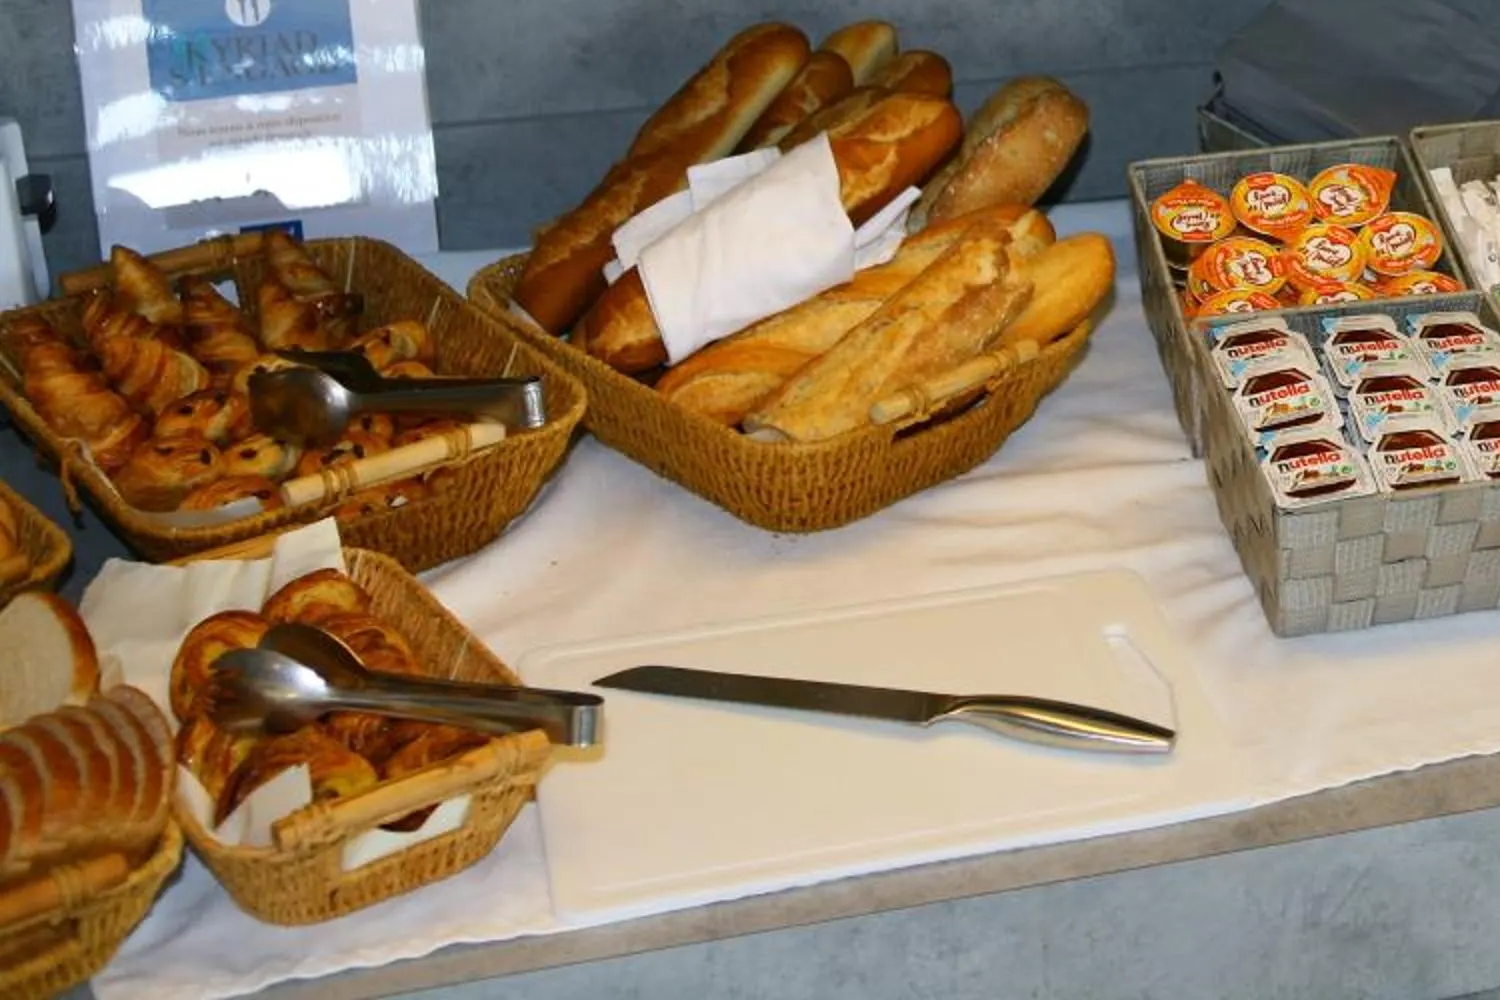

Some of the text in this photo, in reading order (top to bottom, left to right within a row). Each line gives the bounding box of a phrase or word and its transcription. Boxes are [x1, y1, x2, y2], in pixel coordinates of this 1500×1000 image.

[183, 30, 318, 66] KYRIAD
[1228, 337, 1289, 359] nutella
[1339, 338, 1399, 354] nutella
[1427, 333, 1485, 350] nutella
[1249, 383, 1311, 408] nutella
[1363, 389, 1425, 406] nutella
[1278, 452, 1342, 474] nutella
[1384, 445, 1447, 466] nutella
